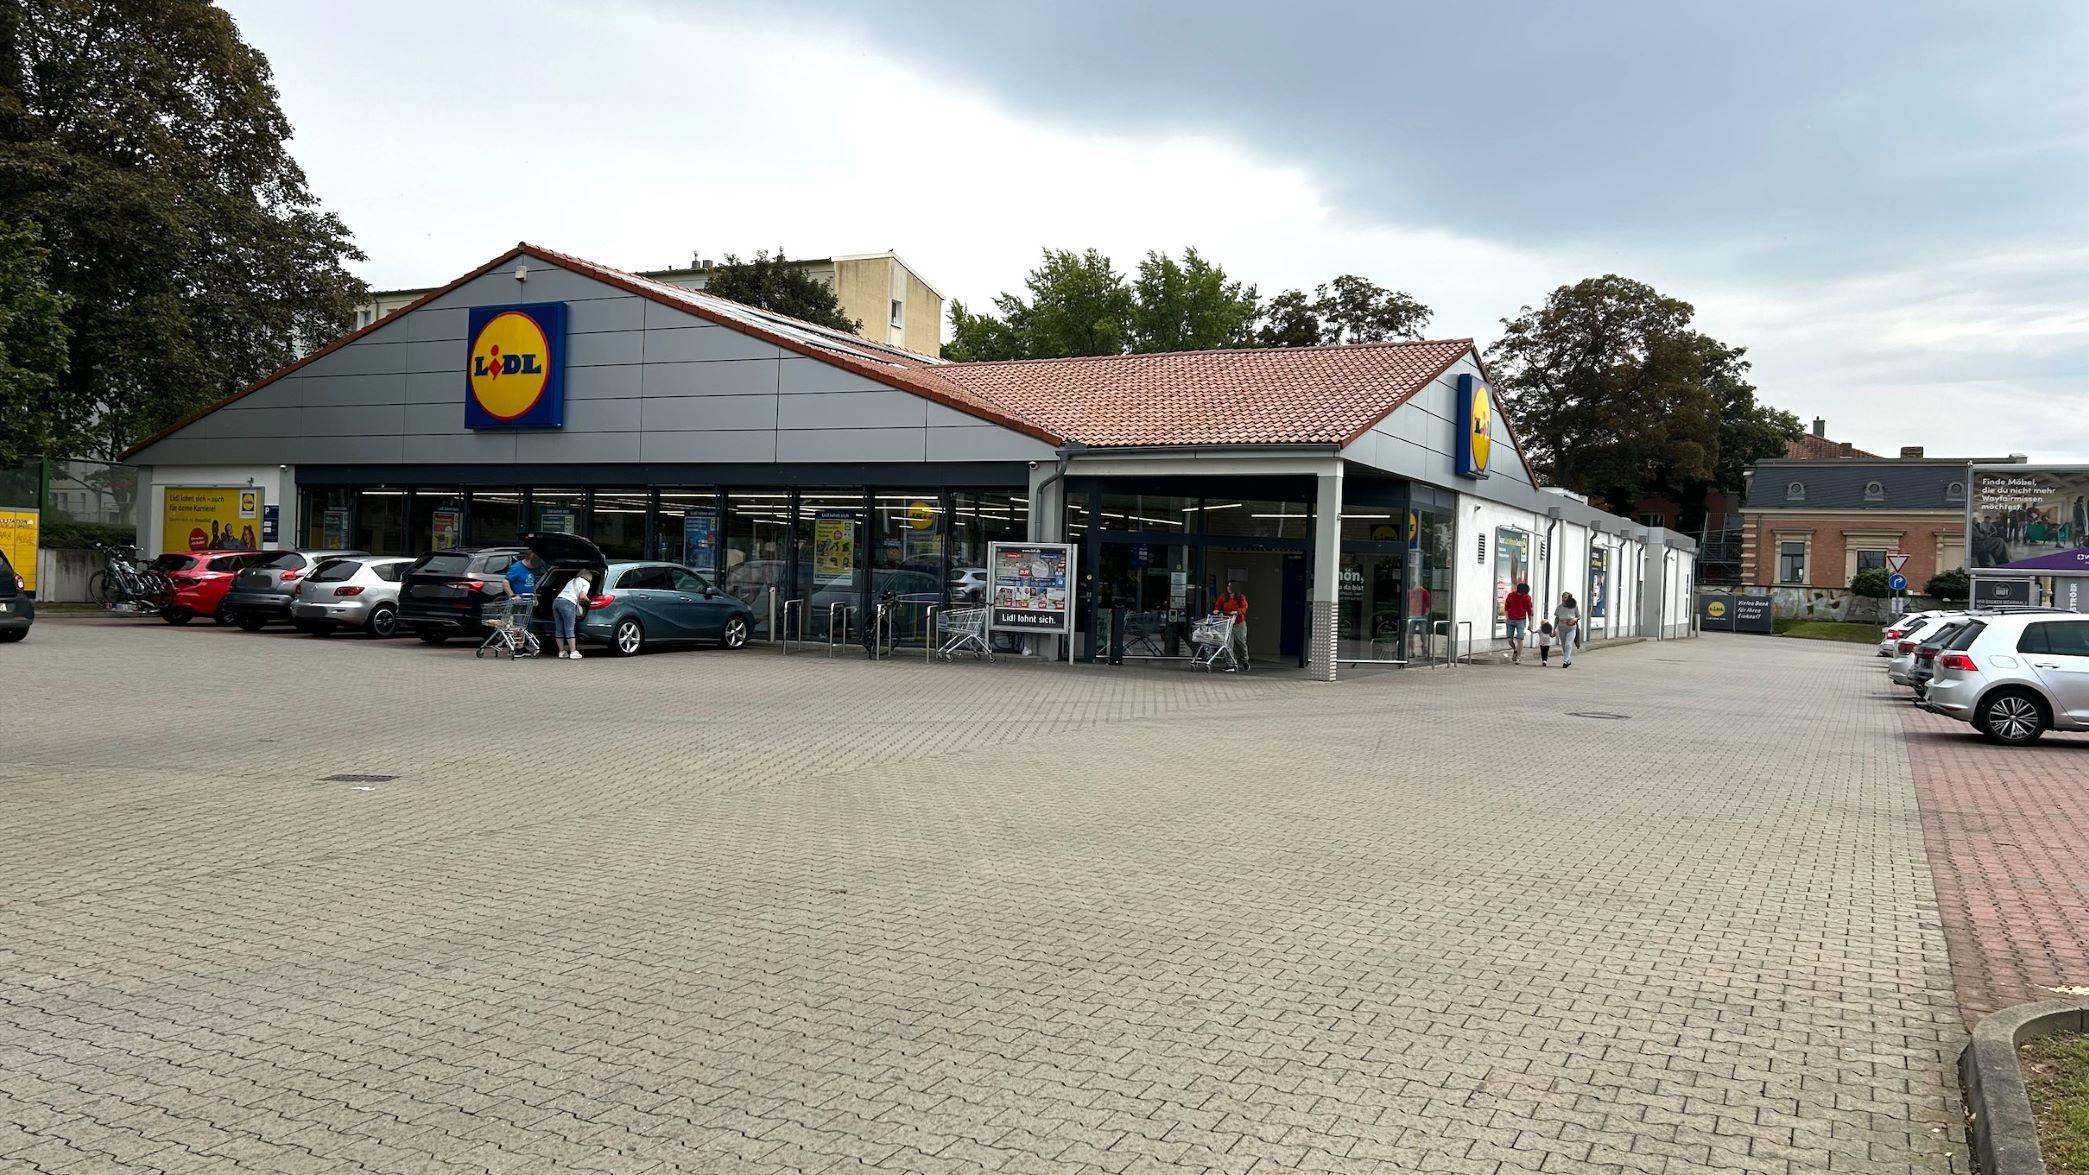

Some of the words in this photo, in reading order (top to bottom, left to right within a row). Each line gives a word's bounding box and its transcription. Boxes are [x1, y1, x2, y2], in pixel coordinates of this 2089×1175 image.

[2008, 478, 2037, 487] Möbel,
[1002, 613, 1015, 621] Lidl
[1018, 614, 1037, 623] lohnt
[1038, 615, 1056, 624] sich.
